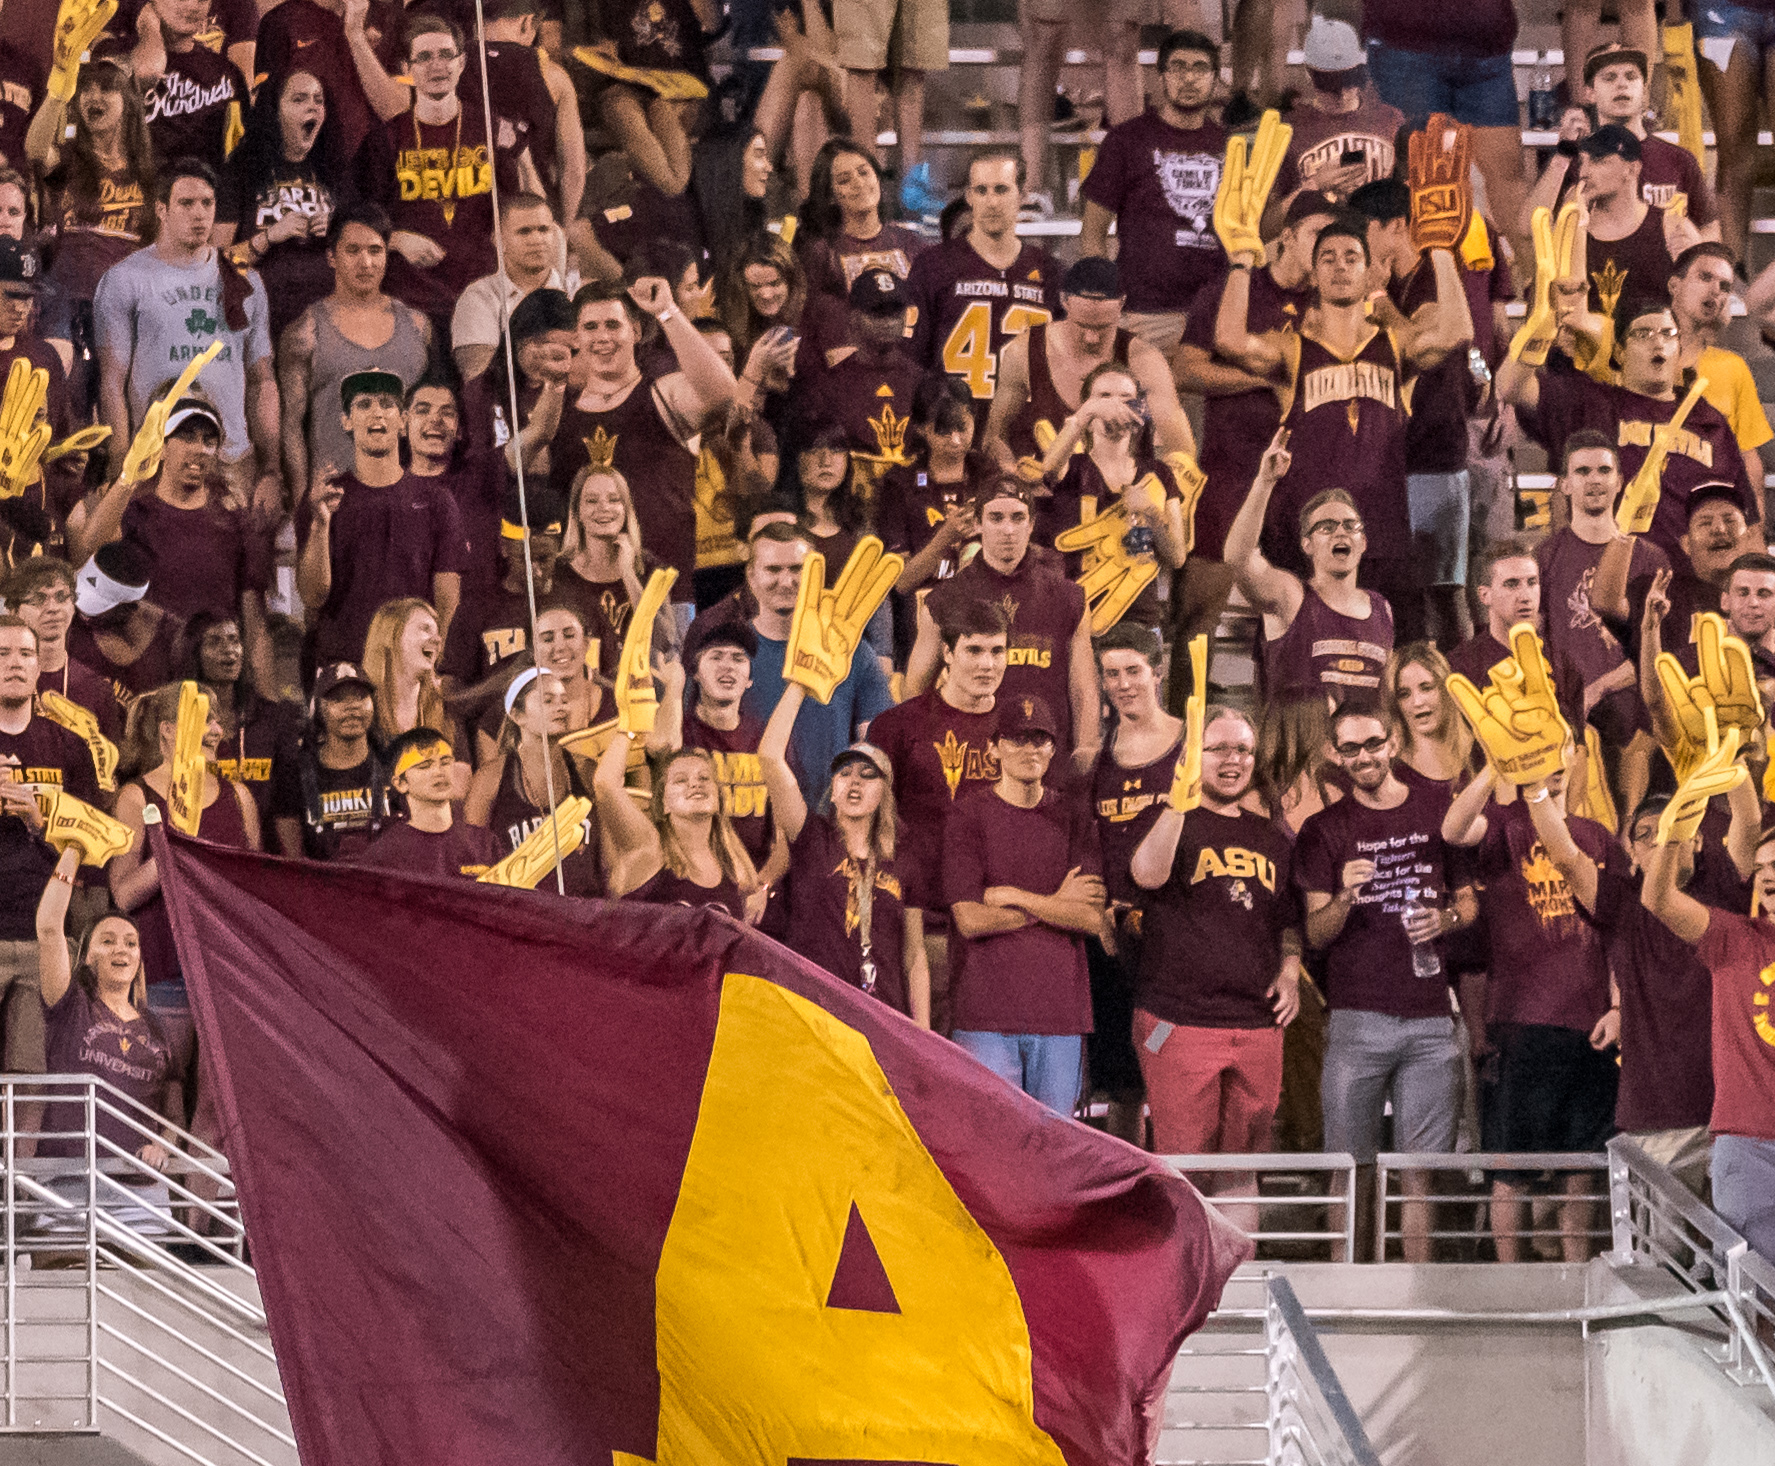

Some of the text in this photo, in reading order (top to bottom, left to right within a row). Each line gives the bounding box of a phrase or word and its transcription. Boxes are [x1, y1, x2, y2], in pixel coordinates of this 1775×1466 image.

[145, 77, 235, 124] Hundreds
[398, 163, 493, 201] DEVILS
[957, 281, 1044, 302] ARIZONA STATE
[1006, 647, 1053, 669] EVILS
[1190, 847, 1276, 893] ASU
